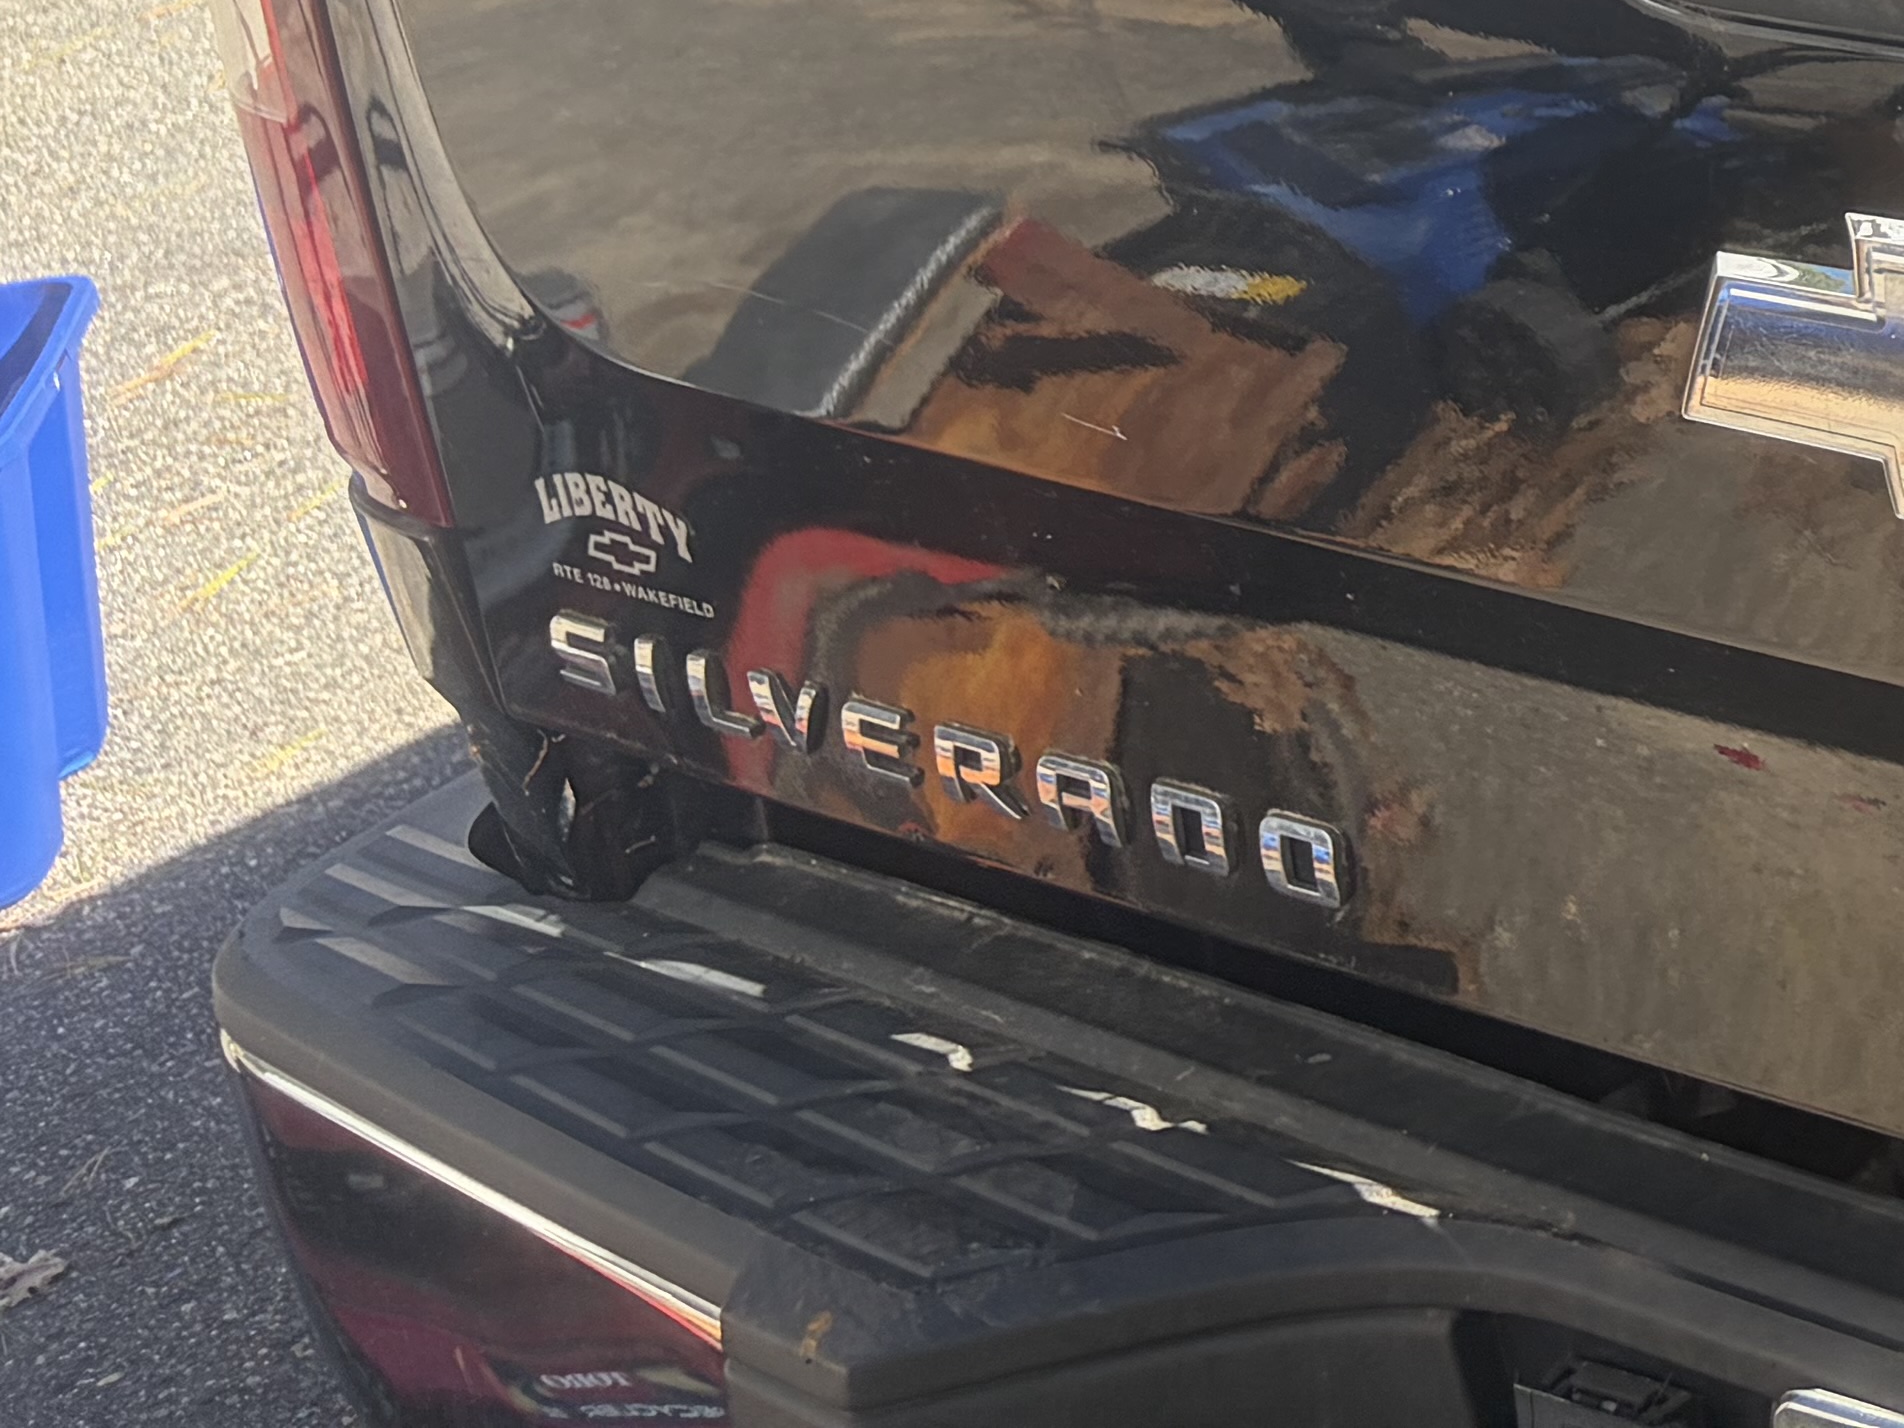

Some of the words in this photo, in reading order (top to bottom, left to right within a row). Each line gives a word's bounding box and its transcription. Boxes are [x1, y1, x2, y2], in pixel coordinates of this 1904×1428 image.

[534, 472, 693, 563] LIBERTY
[552, 562, 584, 583] RTE
[621, 581, 715, 618] WAKEFIELD
[549, 607, 1355, 909] SILVERADO
